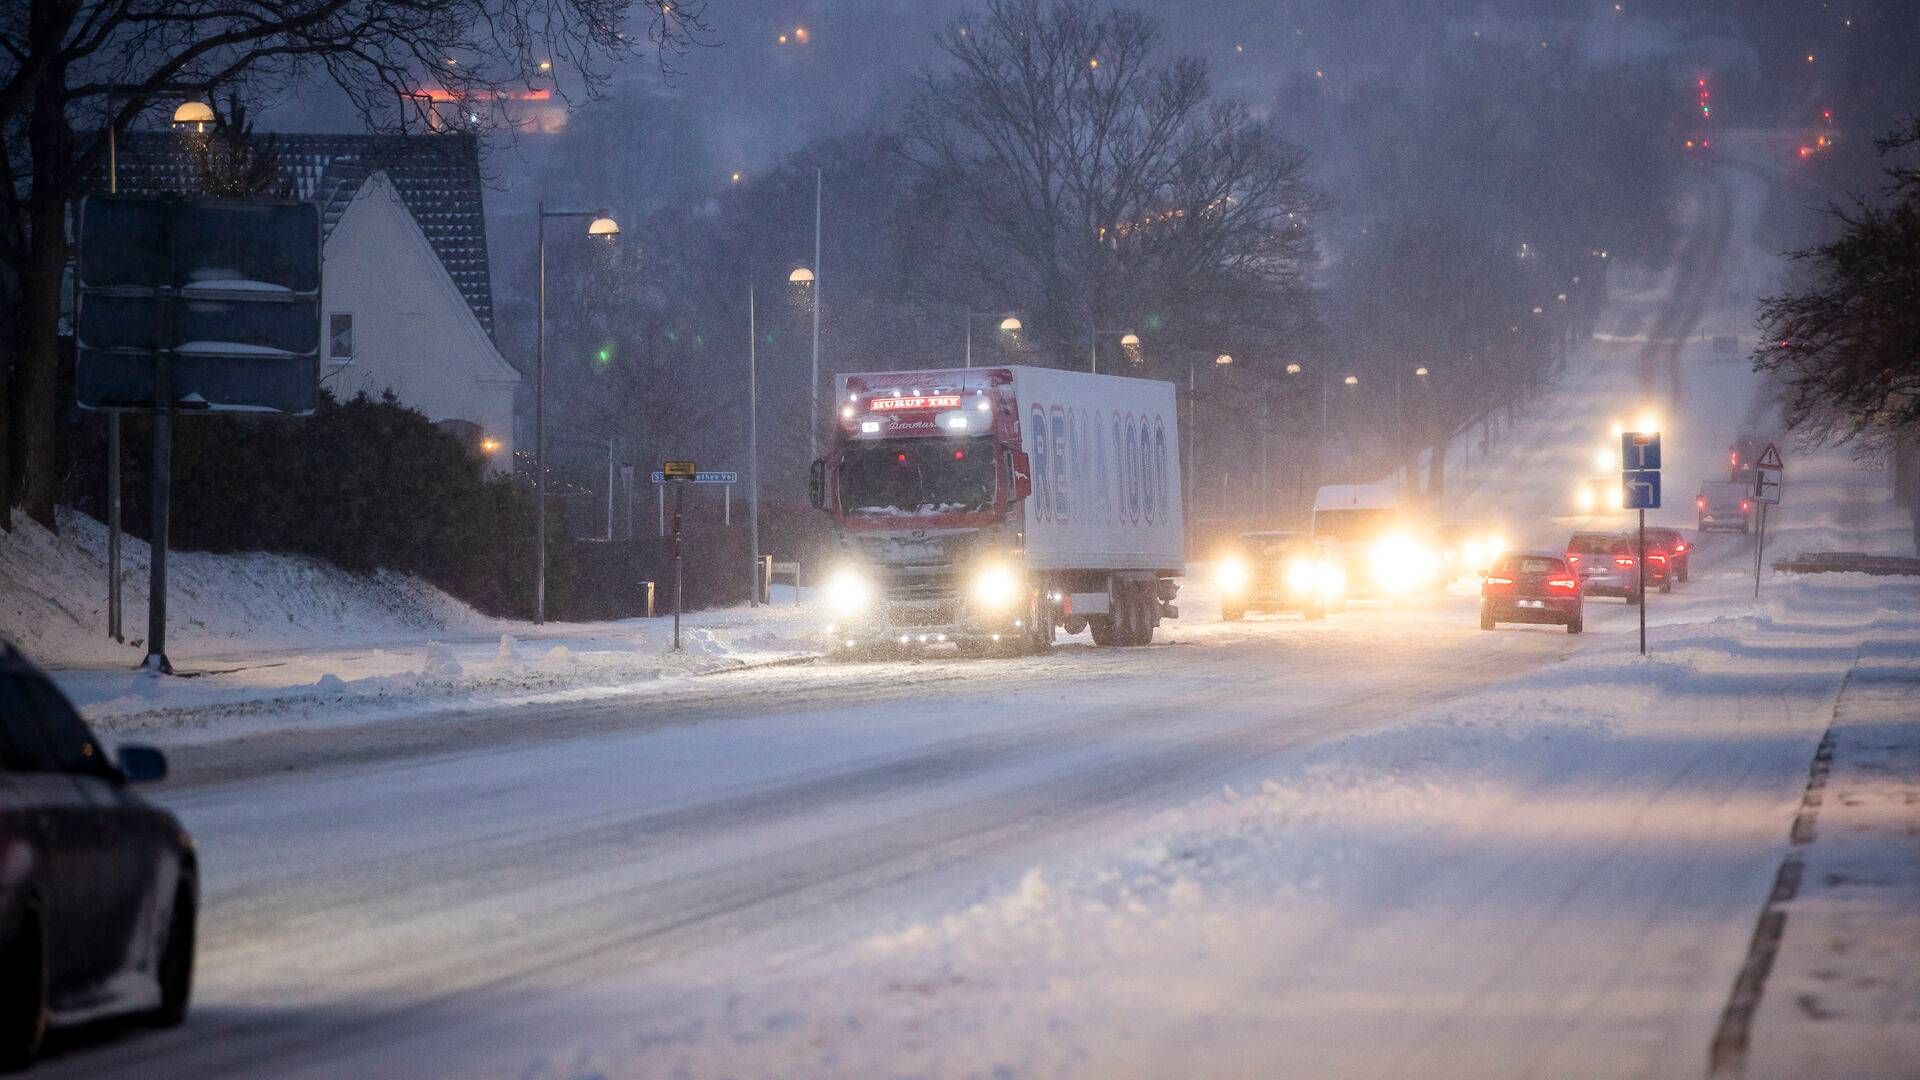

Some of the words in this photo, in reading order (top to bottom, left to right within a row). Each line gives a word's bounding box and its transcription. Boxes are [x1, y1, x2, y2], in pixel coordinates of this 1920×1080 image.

[873, 398, 926, 410] HURUP
[928, 398, 959, 407] THY
[888, 420, 937, 432] Danmar
